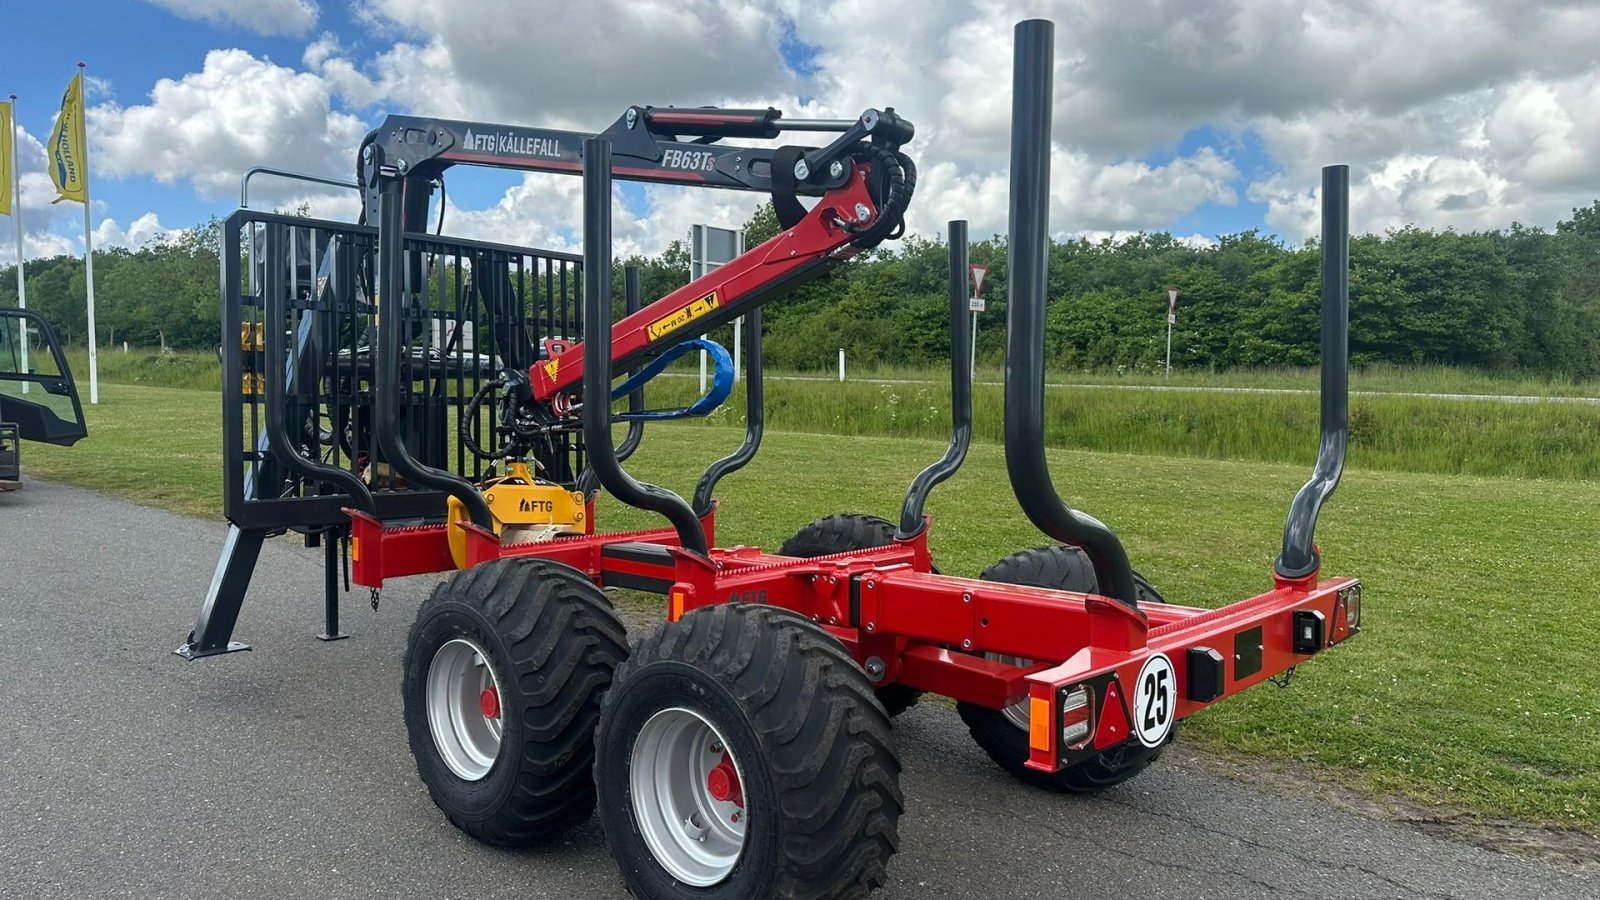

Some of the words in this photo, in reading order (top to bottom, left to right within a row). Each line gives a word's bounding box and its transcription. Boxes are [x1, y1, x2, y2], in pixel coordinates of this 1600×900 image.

[474, 134, 496, 151] FTG
[499, 131, 561, 158] KÄLLEFALL
[61, 134, 76, 183] HOLLAND
[531, 500, 553, 512] FTG
[742, 589, 768, 604] FTG
[1143, 668, 1168, 731] 25
